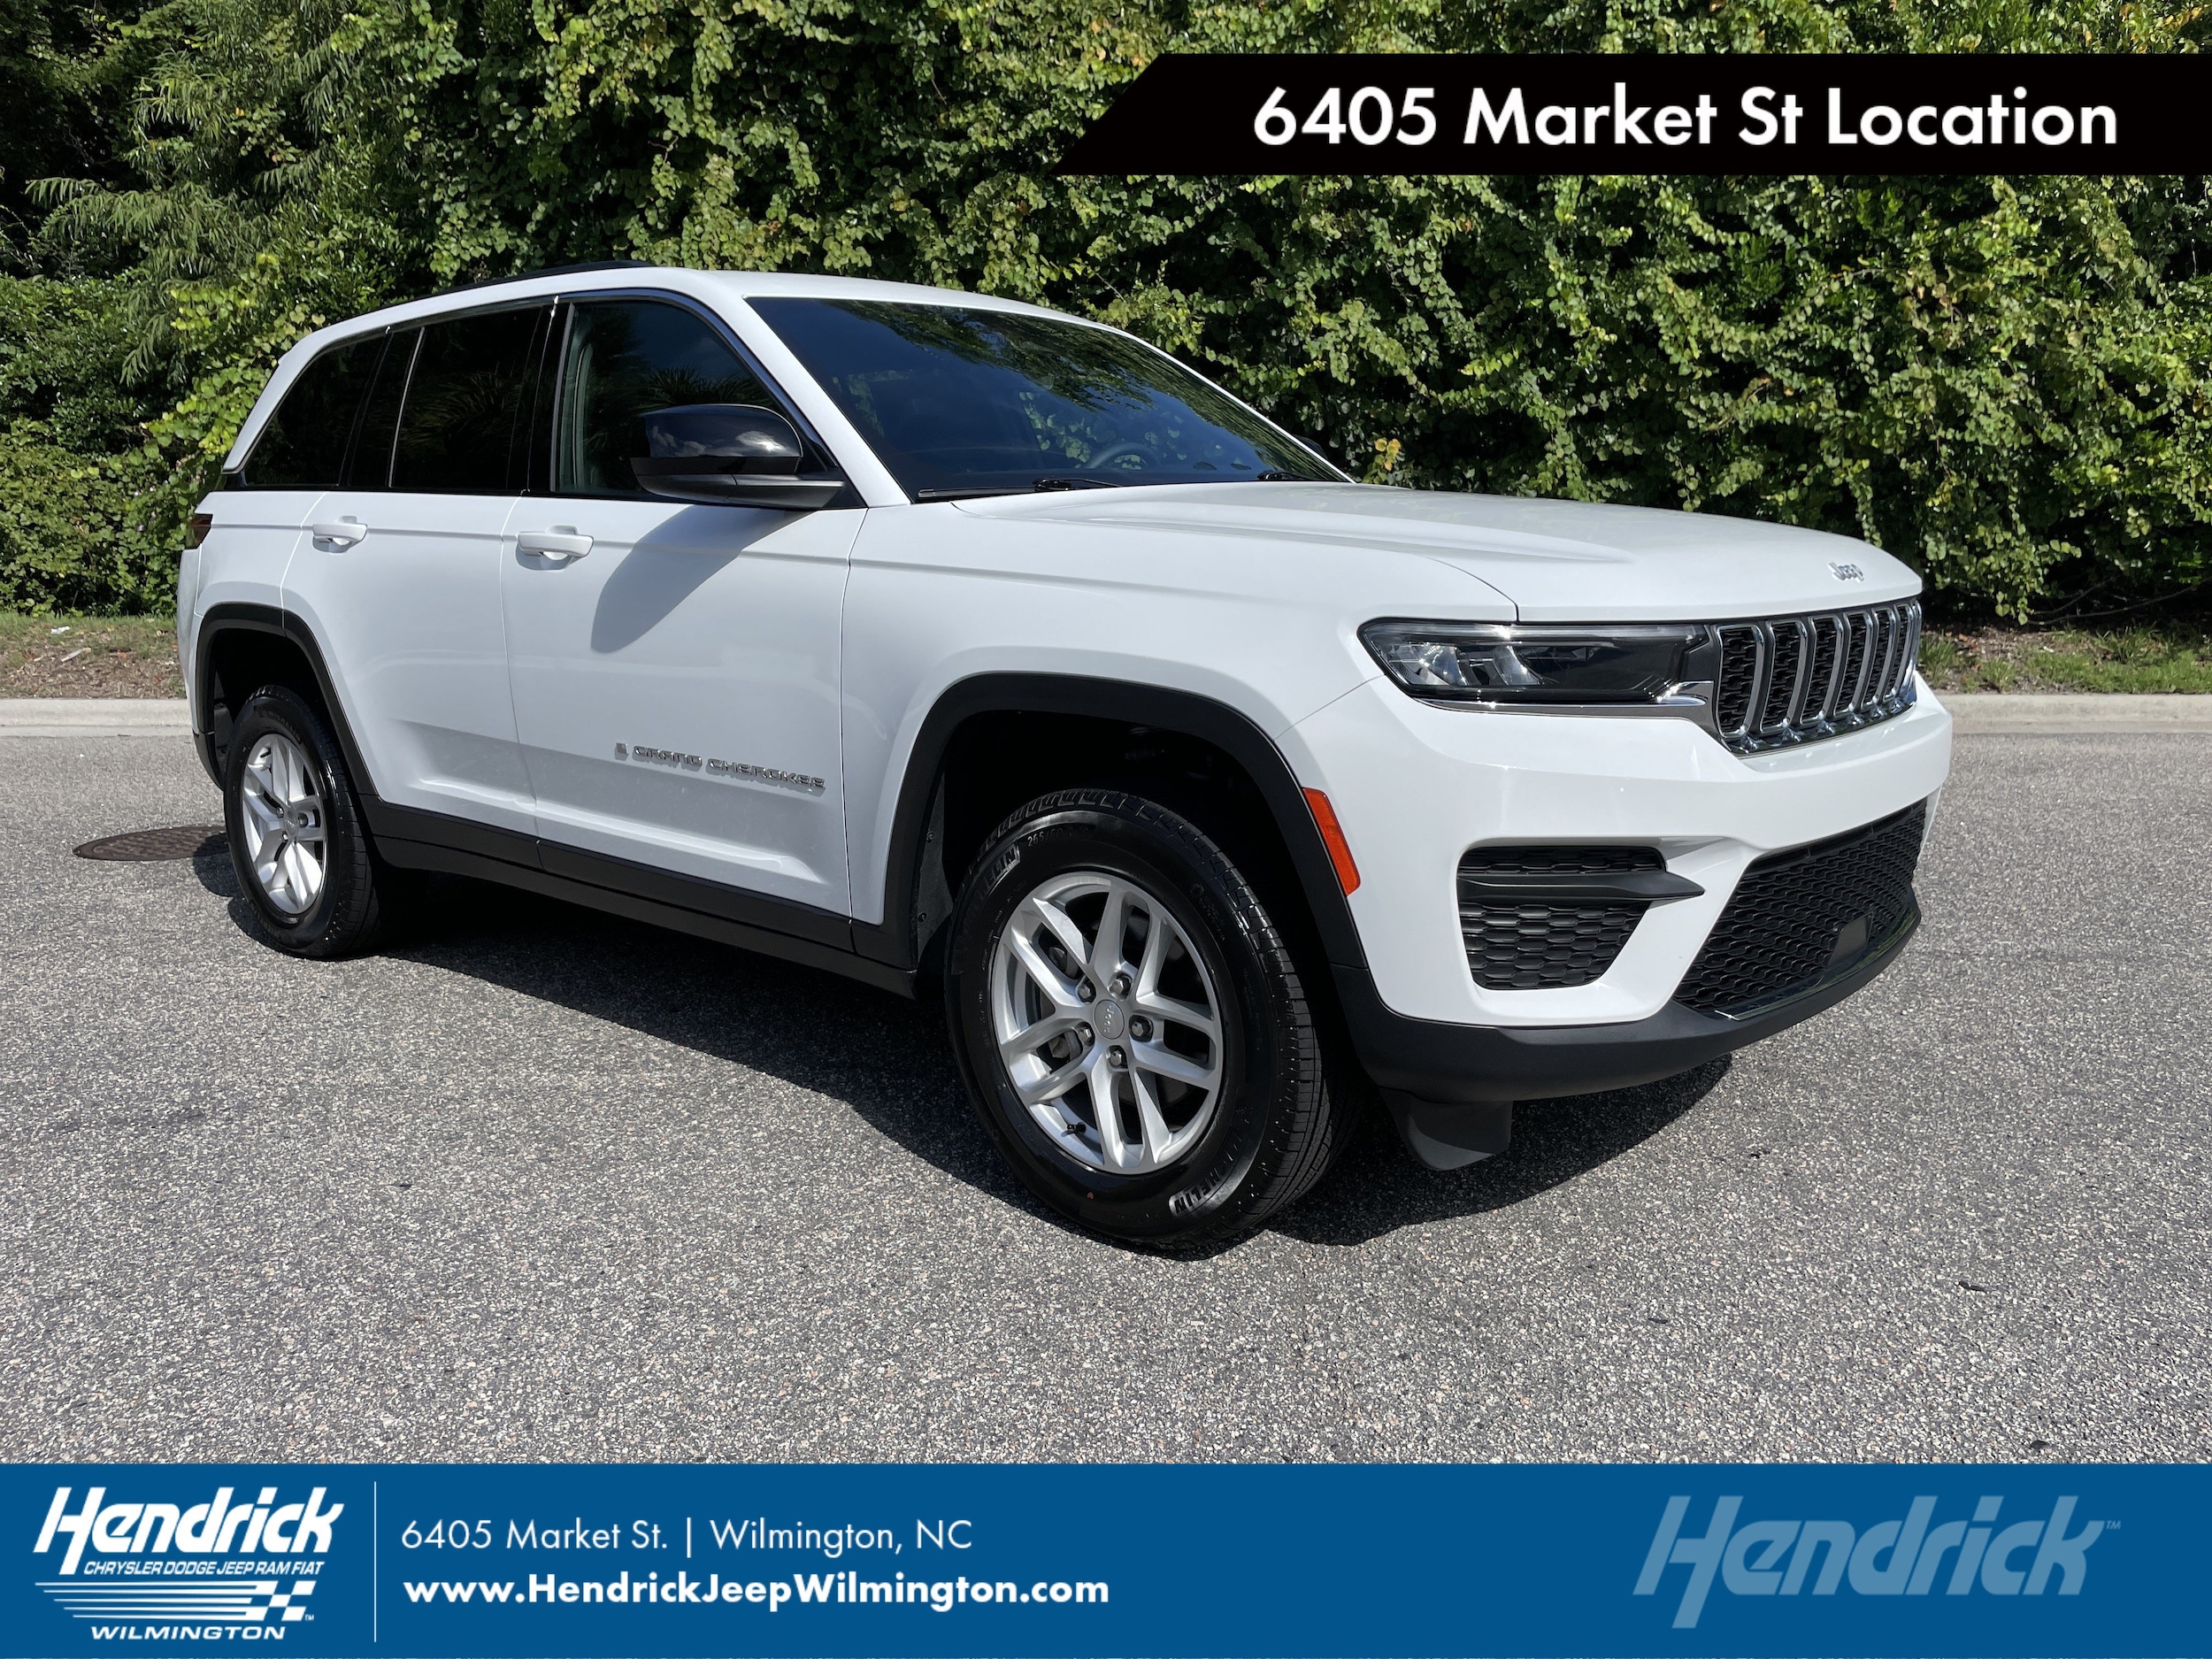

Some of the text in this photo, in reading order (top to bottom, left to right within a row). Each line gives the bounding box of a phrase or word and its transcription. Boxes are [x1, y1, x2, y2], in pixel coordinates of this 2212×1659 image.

[1828, 562, 1864, 581] Jeep
[634, 746, 826, 789] GRAND CHEROKEE
